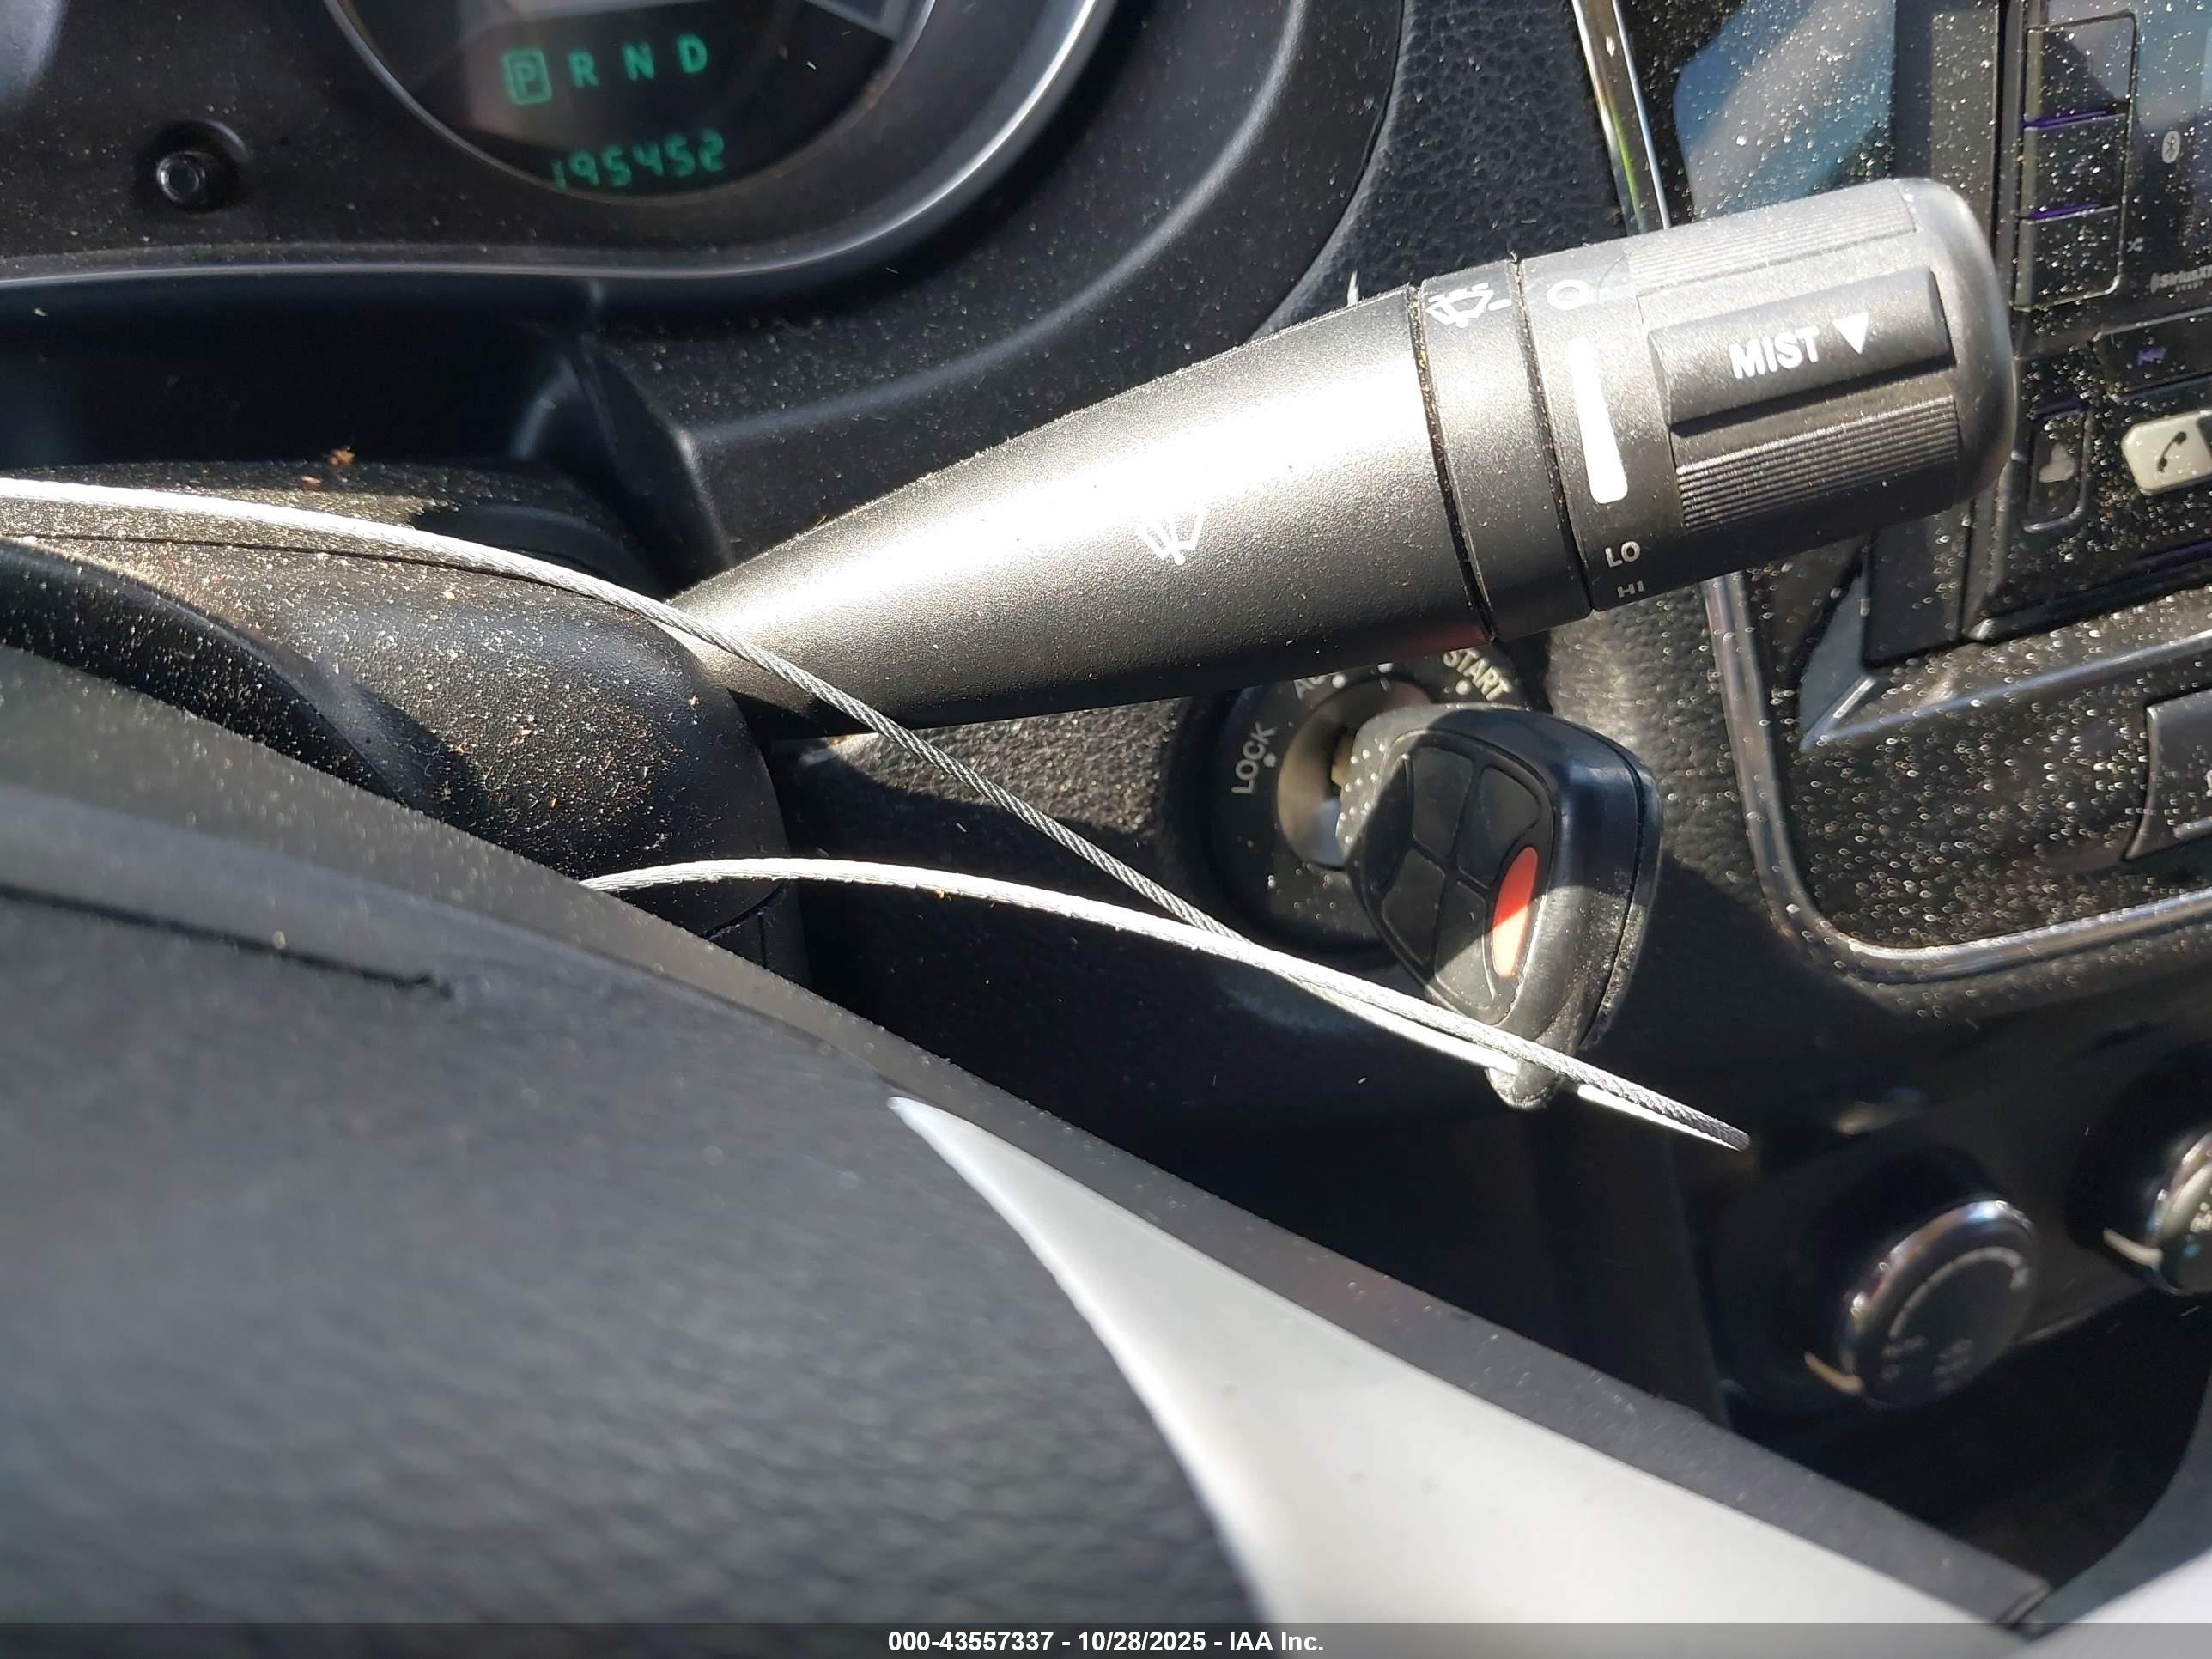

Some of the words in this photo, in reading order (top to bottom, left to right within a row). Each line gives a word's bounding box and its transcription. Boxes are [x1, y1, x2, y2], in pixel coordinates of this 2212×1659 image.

[568, 49, 600, 88] R
[622, 40, 655, 82] N
[676, 33, 708, 74] D
[550, 128, 726, 191] 195452
[1729, 325, 1821, 380] MIST
[1605, 540, 1641, 568] LO
[1617, 580, 1644, 599] HI
[1443, 647, 1513, 702] START
[1231, 721, 1279, 795] LOCK
